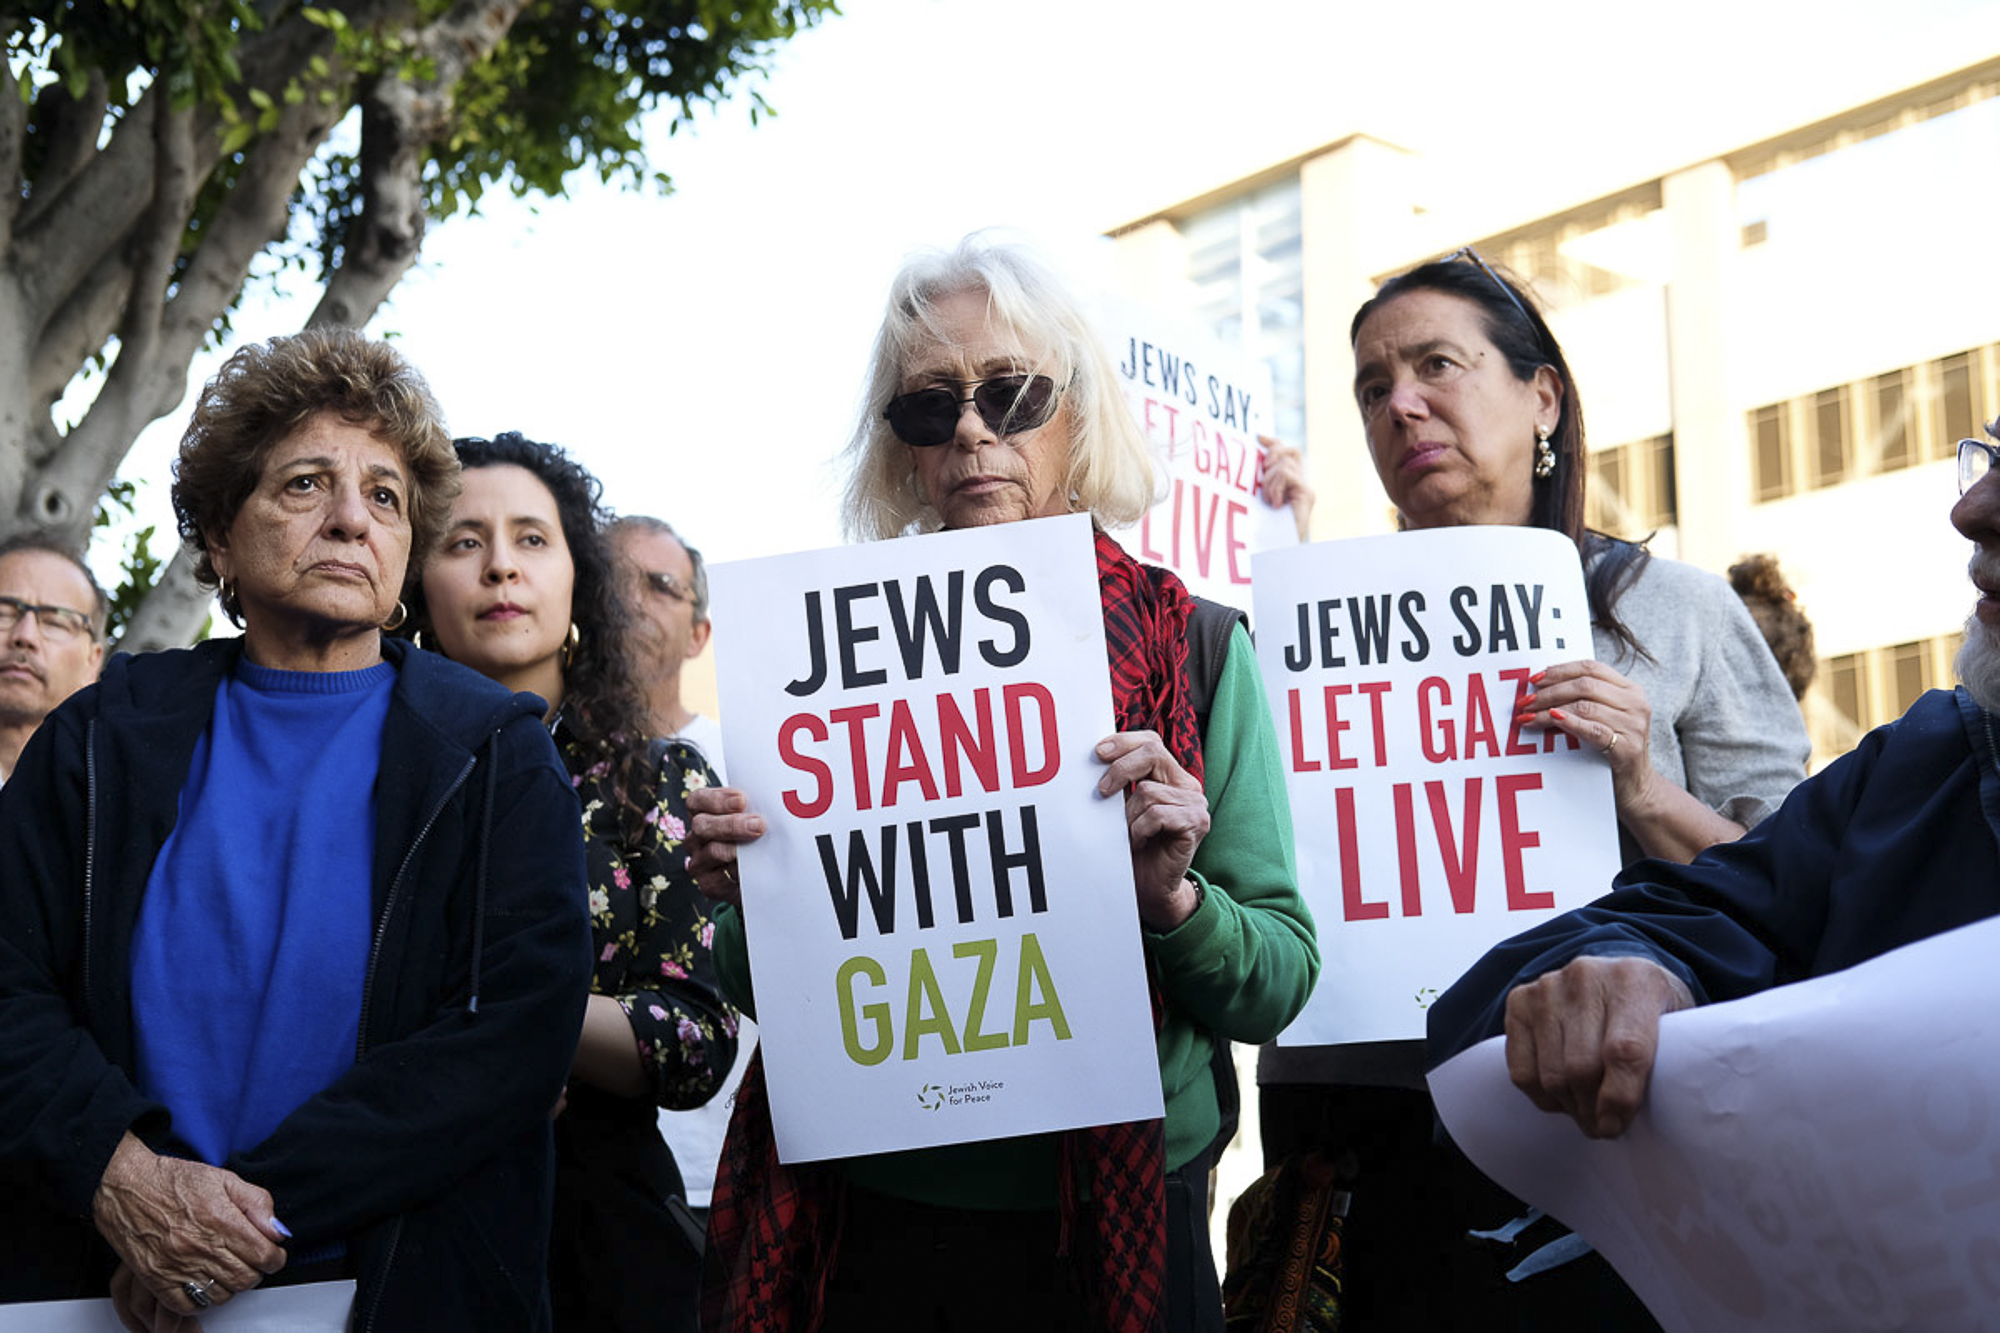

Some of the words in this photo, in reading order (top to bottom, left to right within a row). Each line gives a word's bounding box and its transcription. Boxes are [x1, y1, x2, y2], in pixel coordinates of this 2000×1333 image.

[1121, 337, 1197, 405] JEWS
[1124, 391, 1180, 462] ET
[1141, 478, 1252, 585] LIVE
[785, 565, 1031, 697] JEWS
[1284, 590, 1430, 672] JEWS
[1449, 584, 1566, 657] SAY:
[777, 682, 1061, 819] STAND
[1288, 681, 1392, 773] LET
[815, 805, 1049, 941] WITH
[1334, 772, 1556, 922] LIVE
[836, 933, 1072, 1066] GAZA
[948, 1083, 977, 1095] Jewish
[978, 1081, 1004, 1090] Voice
[949, 1096, 962, 1105] for
[964, 1094, 991, 1103] Peace
